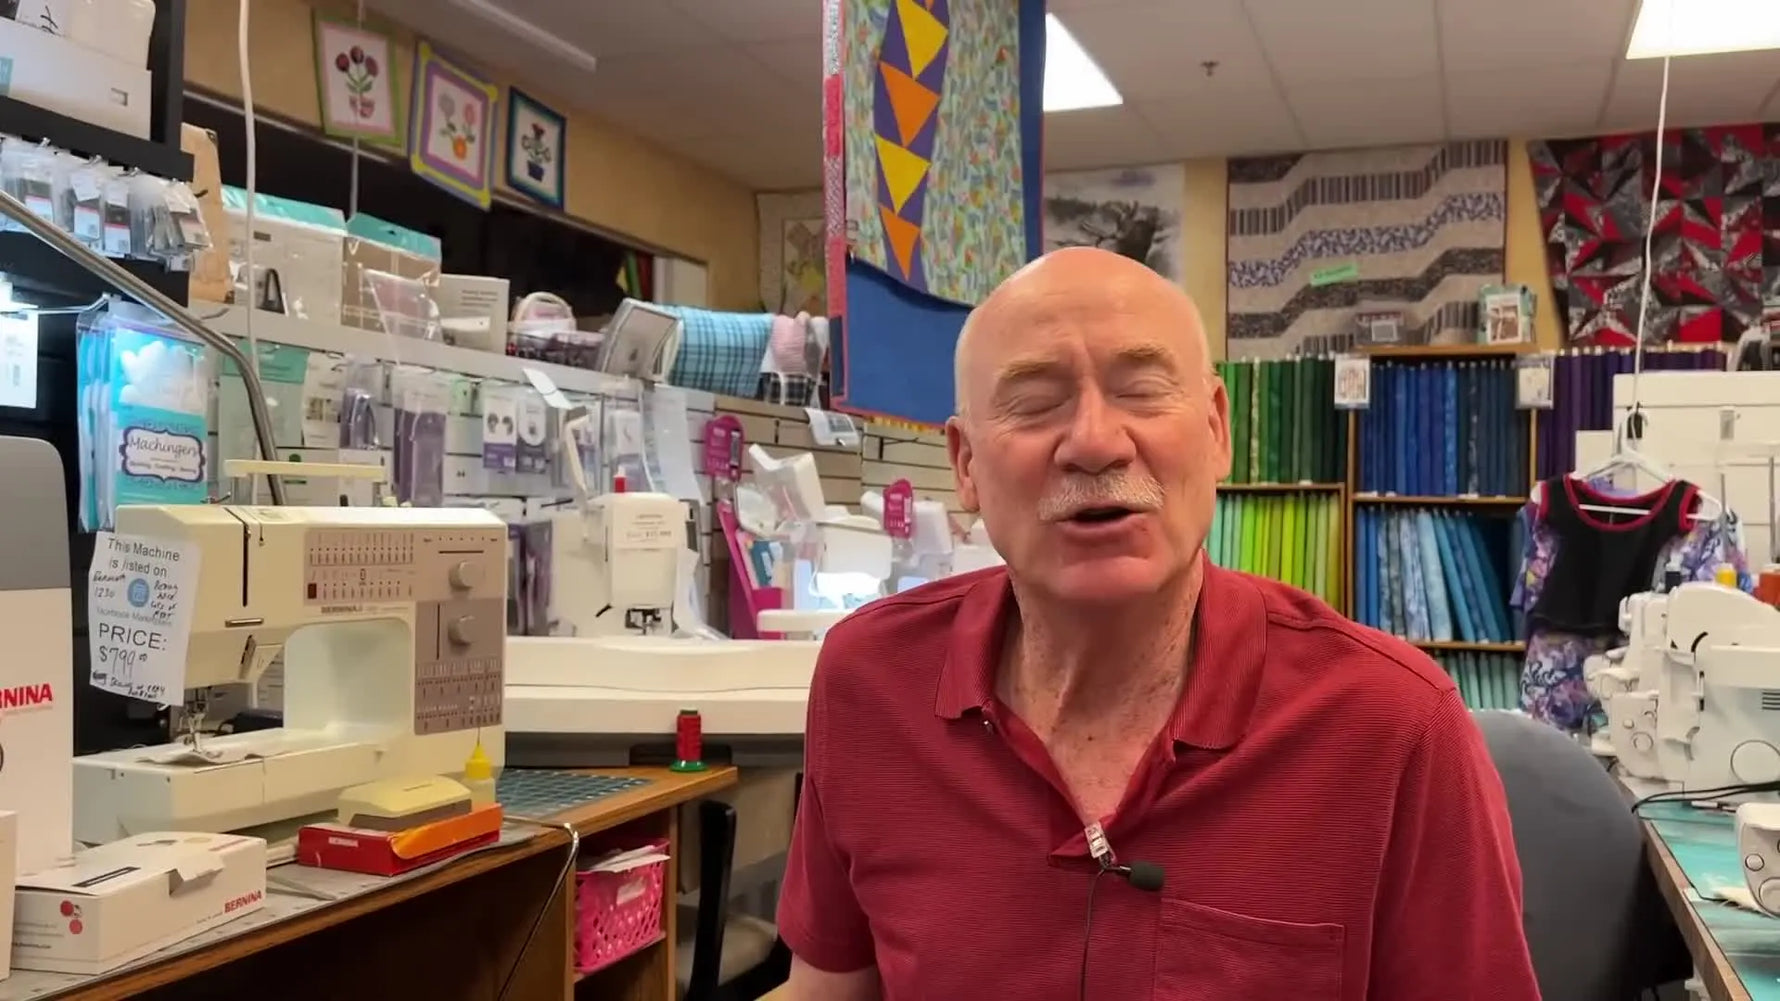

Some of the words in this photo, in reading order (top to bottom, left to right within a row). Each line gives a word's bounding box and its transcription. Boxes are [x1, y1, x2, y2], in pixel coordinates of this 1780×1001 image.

[108, 537, 131, 553] This
[133, 542, 181, 561] Machine
[109, 557, 119, 569] is
[121, 559, 151, 574] listed
[153, 566, 168, 577] on
[99, 622, 167, 651] PRICE:
[0, 683, 53, 709] NINA
[224, 890, 262, 913] BERNINA
